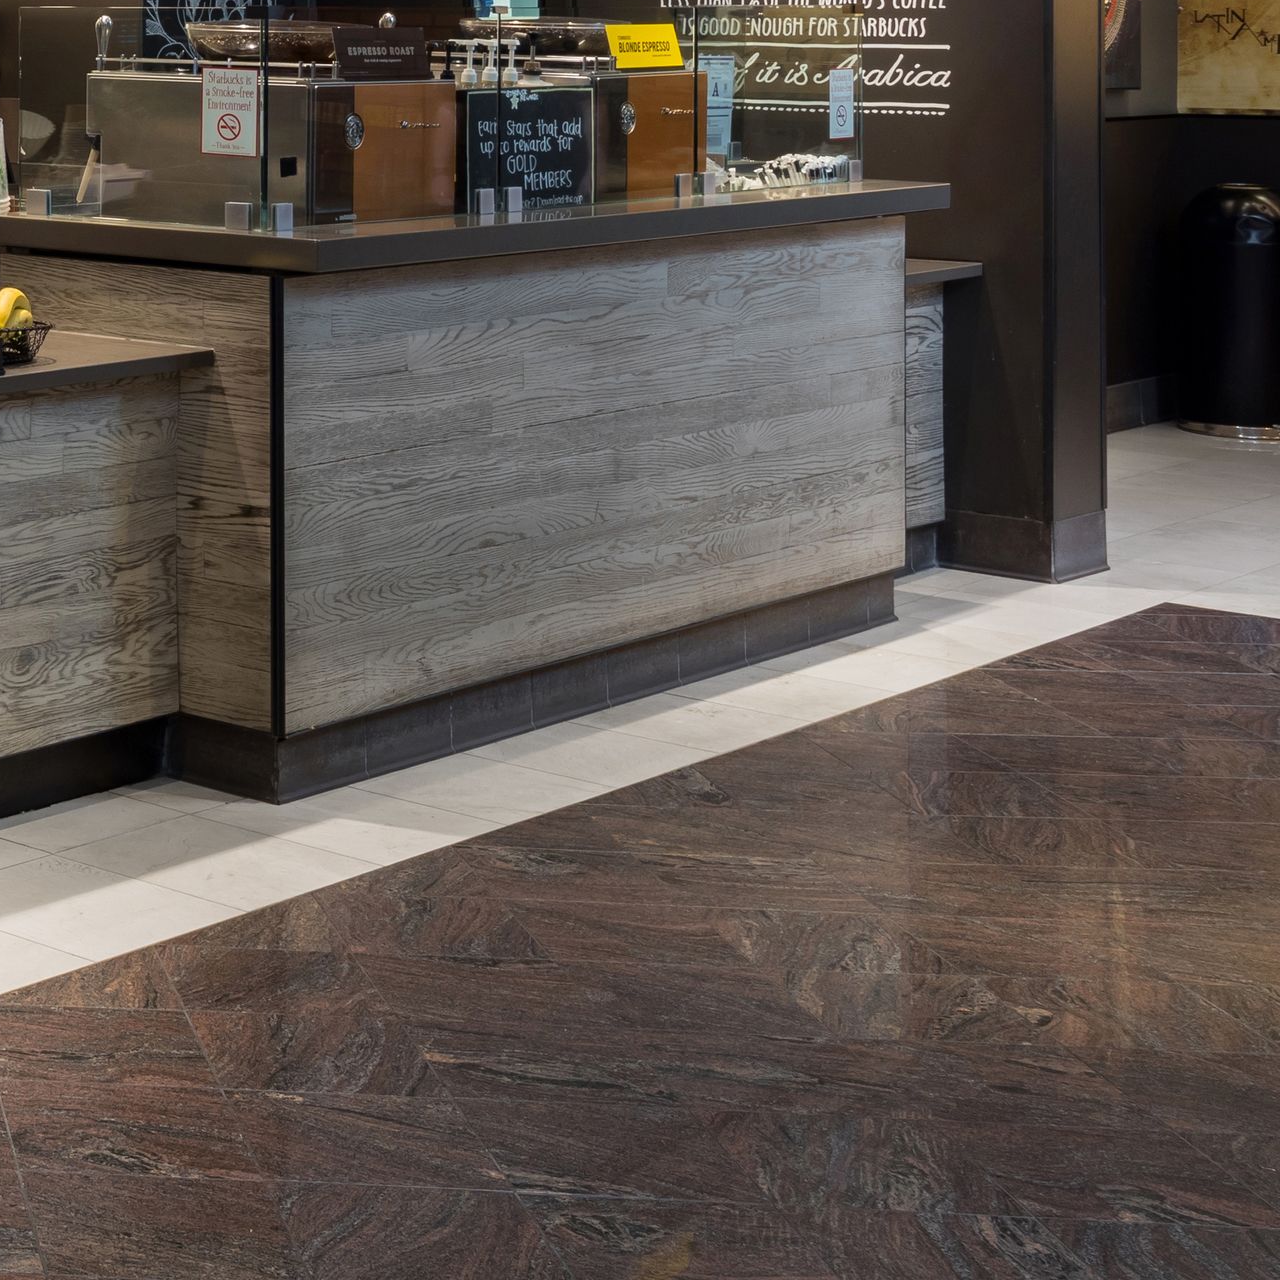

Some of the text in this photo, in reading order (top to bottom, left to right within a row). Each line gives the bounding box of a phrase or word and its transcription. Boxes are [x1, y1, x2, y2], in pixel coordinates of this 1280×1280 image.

[699, 18, 740, 37] GOOD
[745, 17, 803, 38] ENOUGH
[808, 17, 837, 37] FOR
[843, 17, 927, 38] STARBUCKS
[1194, 8, 1248, 35] LATIN
[348, 46, 415, 56] ESPRESSO ROAST
[618, 40, 670, 54] BLONDE ESPRESSO
[208, 71, 252, 86] Starbucks is
[756, 60, 782, 86] it
[785, 61, 809, 86] is
[212, 86, 255, 98] Smoke-free
[712, 82, 719, 97] A
[208, 98, 252, 112] Environment
[506, 120, 532, 136] Stars
[537, 120, 558, 136] that
[562, 119, 583, 138] add
[480, 141, 494, 158] up
[513, 136, 552, 154] rewards
[557, 136, 574, 152] for
[506, 154, 537, 174] GOLD
[524, 170, 572, 191] MEMBERS
